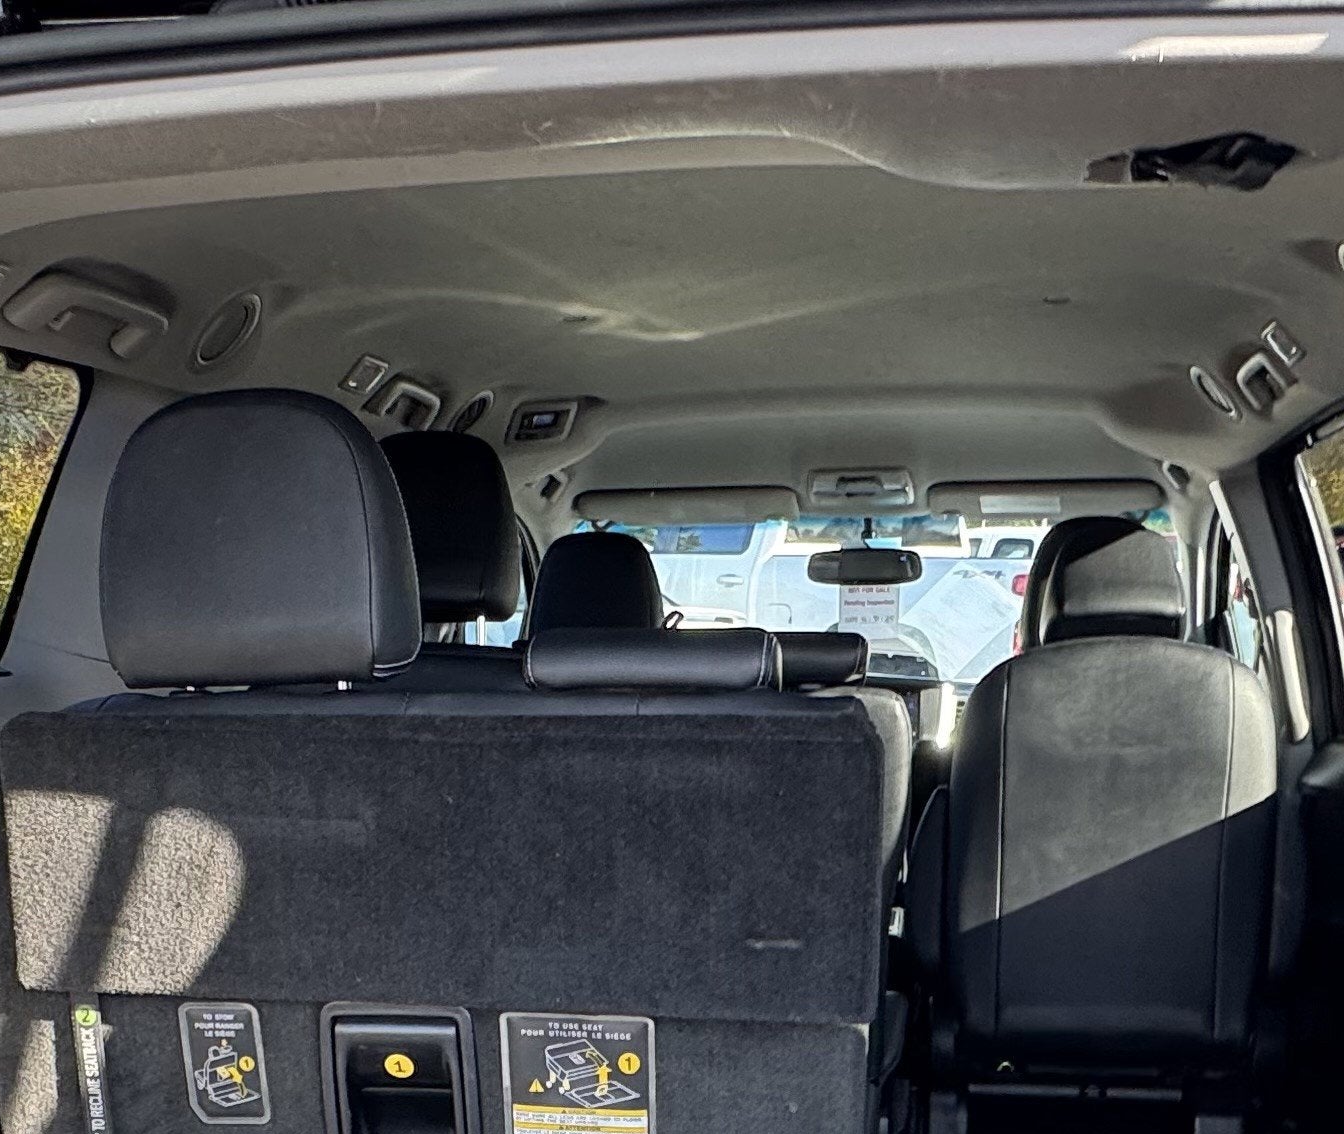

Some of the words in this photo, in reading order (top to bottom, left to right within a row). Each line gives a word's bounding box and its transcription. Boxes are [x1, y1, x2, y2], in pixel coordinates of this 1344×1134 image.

[80, 1008, 90, 1022] 2
[548, 1022, 559, 1030] TO
[562, 1022, 579, 1030] USE
[582, 1023, 604, 1031] SEAT
[520, 1028, 544, 1037] POUR
[548, 1030, 588, 1038] UTILISER
[591, 1031, 602, 1039] LE
[80, 1027, 99, 1077] SEATBACK
[393, 1060, 406, 1073] 1
[87, 1078, 105, 1118] RECLINE
[91, 1118, 106, 1131] TO
